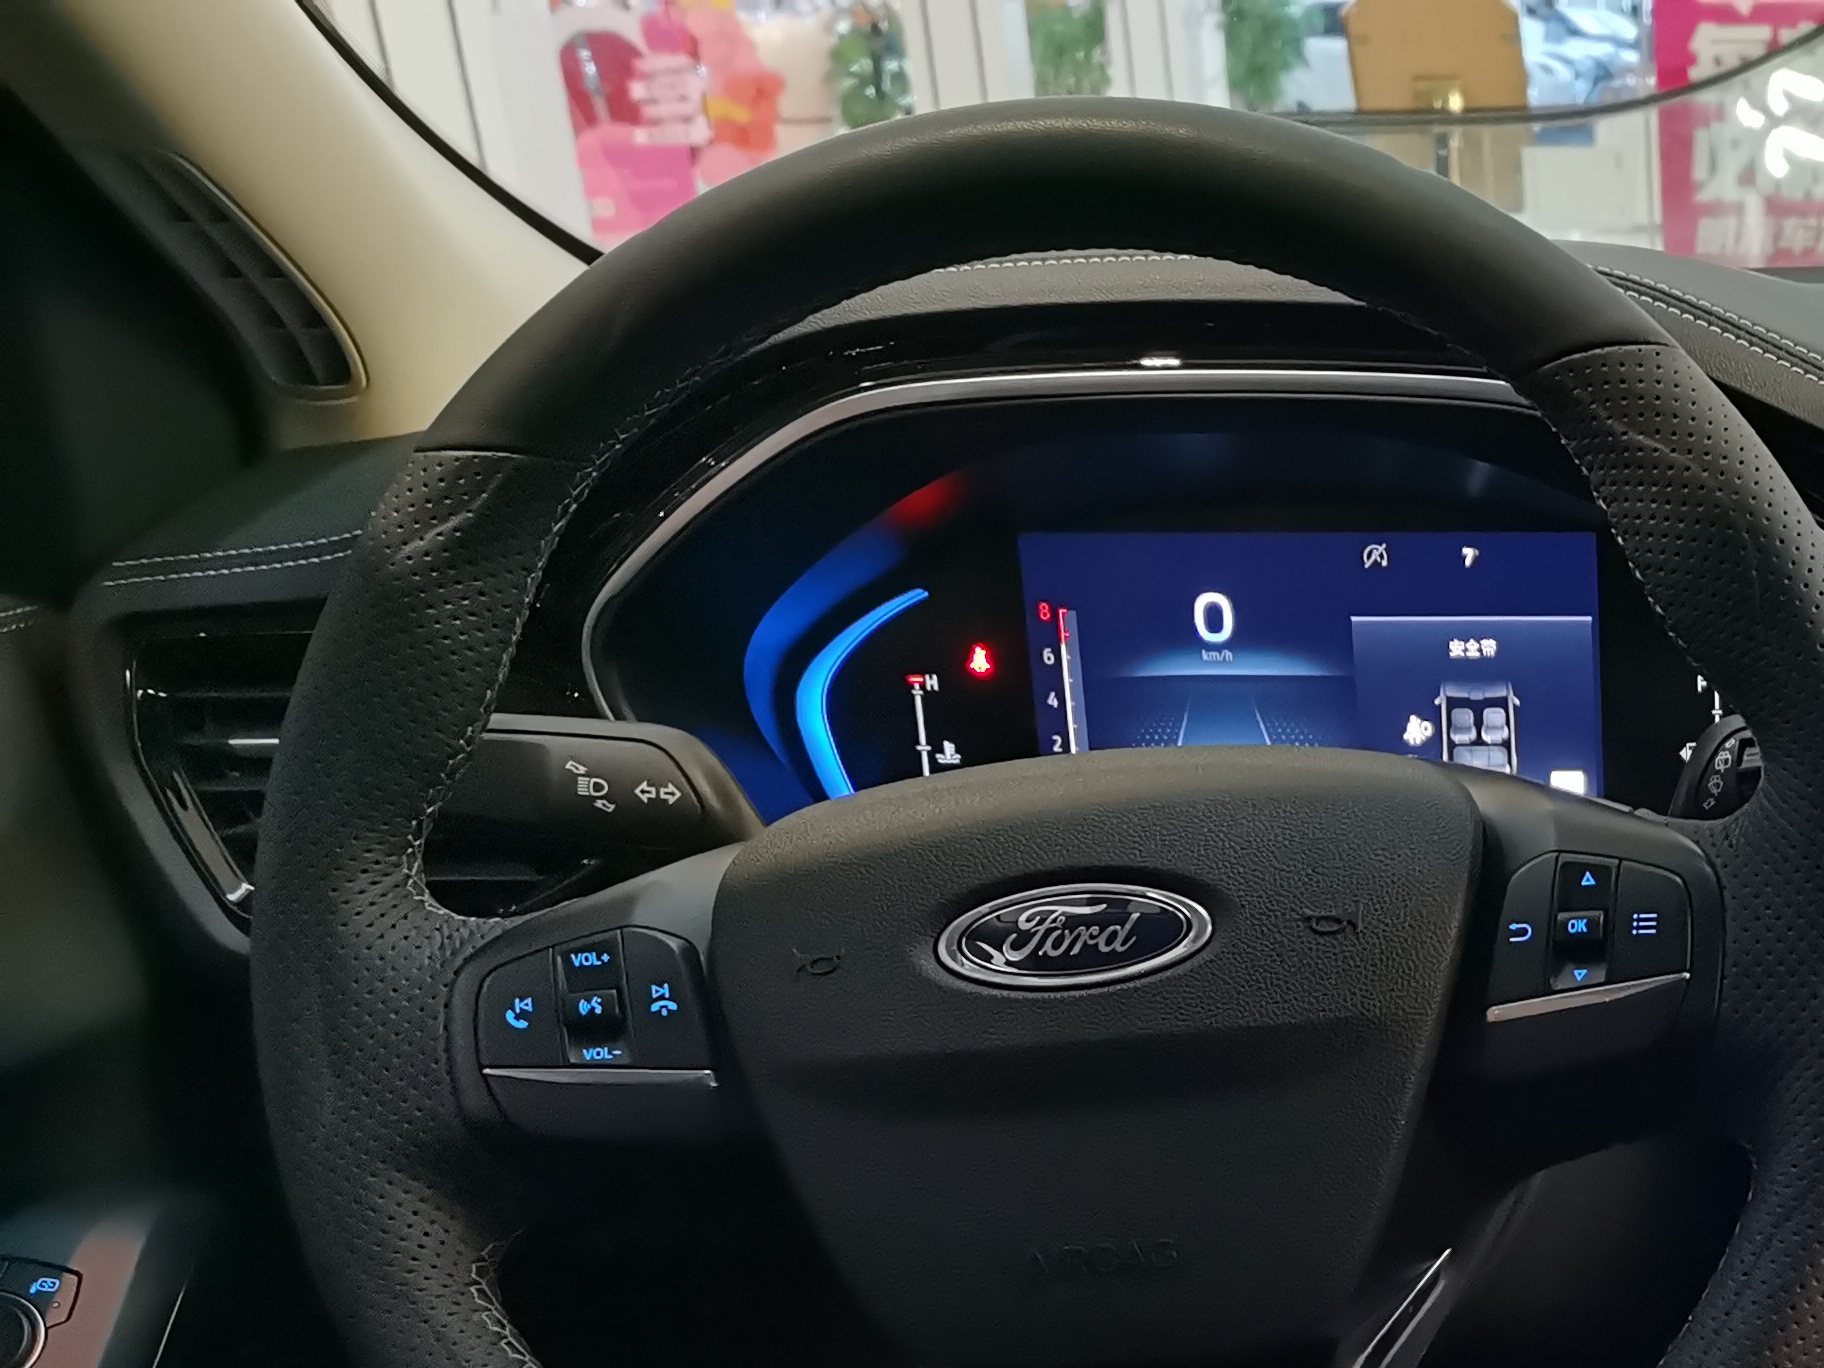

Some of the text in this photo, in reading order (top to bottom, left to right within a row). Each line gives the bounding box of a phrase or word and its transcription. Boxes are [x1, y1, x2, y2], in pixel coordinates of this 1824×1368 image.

[1037, 602, 1051, 622] 8
[1194, 591, 1235, 643] 0
[1042, 648, 1055, 665] 6
[1201, 649, 1234, 663] km/h
[1449, 638, 1498, 659] 安全带
[1046, 691, 1059, 708] 4
[1051, 735, 1063, 752] 2
[1001, 902, 1141, 963] Ford
[1567, 918, 1588, 934] OK
[570, 951, 611, 968] VOL+
[583, 1046, 623, 1061] VOL-
